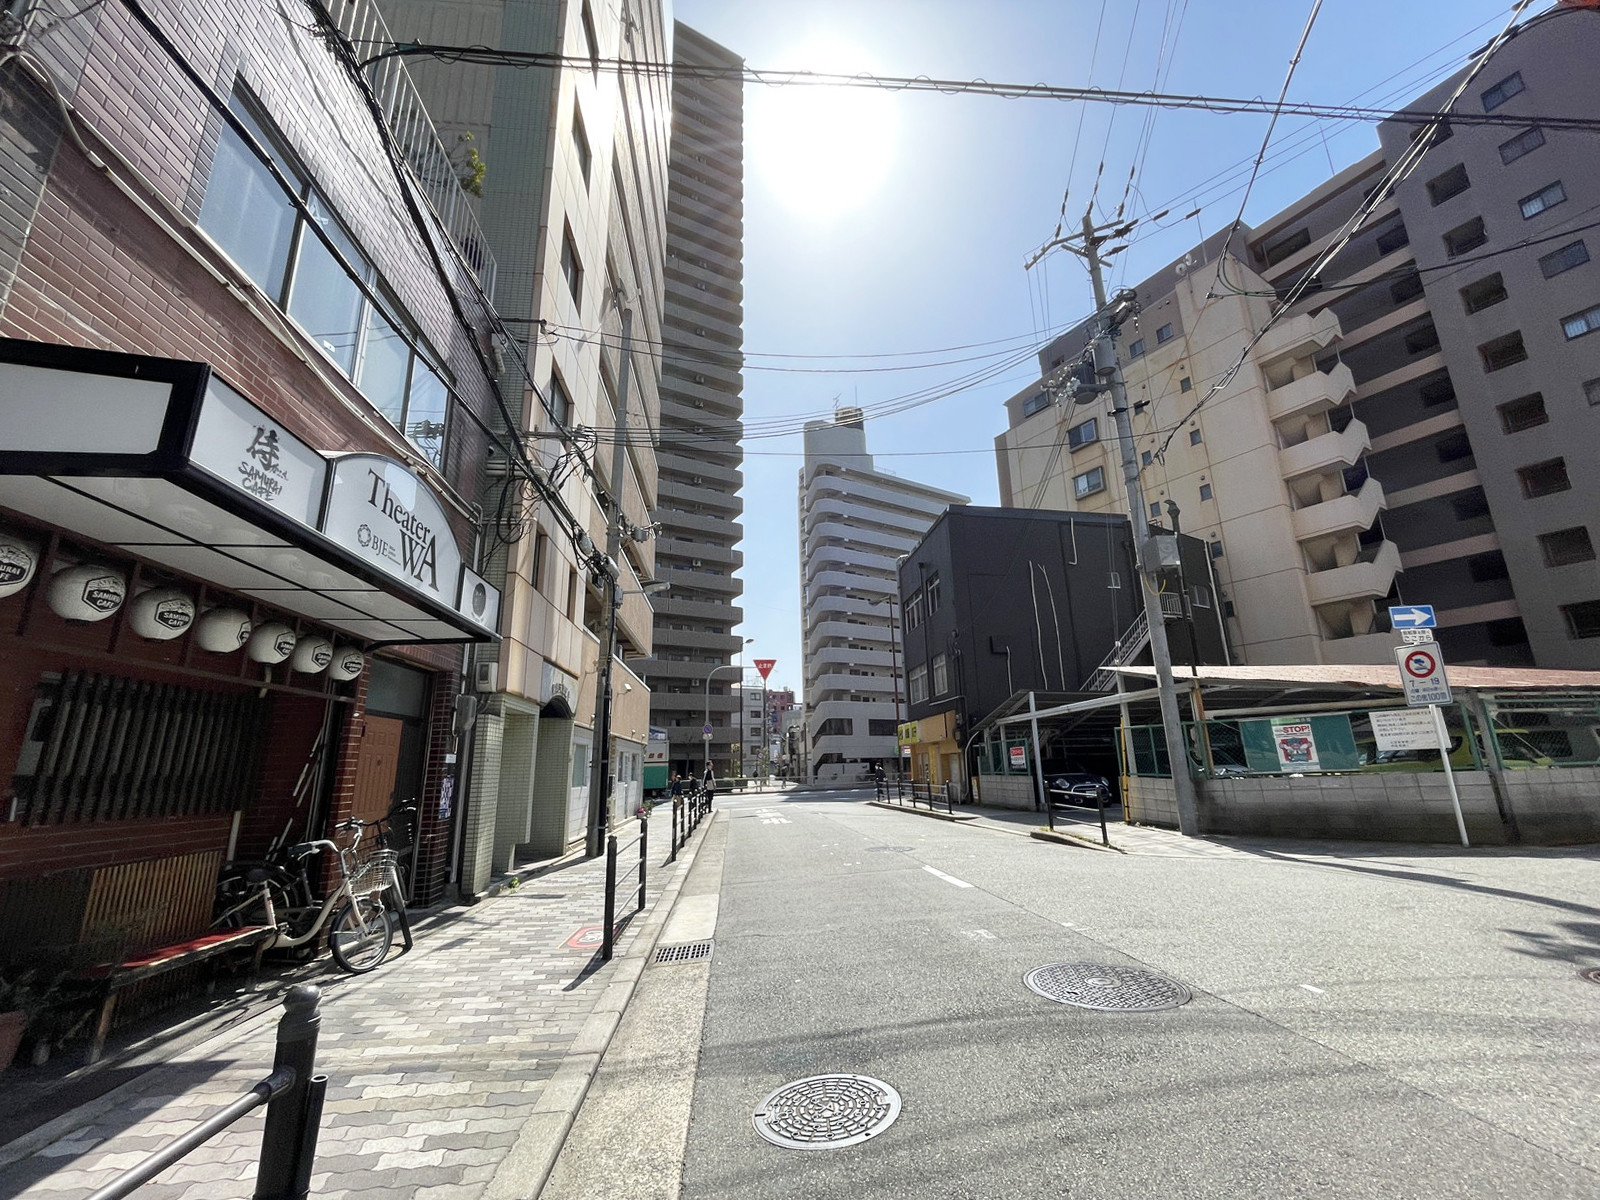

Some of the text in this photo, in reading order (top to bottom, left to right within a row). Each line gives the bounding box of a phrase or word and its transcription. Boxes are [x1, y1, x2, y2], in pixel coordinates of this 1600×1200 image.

[238, 461, 282, 495] SAMURAI
[242, 477, 274, 501] CAFE
[367, 467, 431, 545] Theater
[371, 535, 389, 558] BJE
[399, 528, 440, 592] WA
[1283, 725, 1310, 733] STOP!
